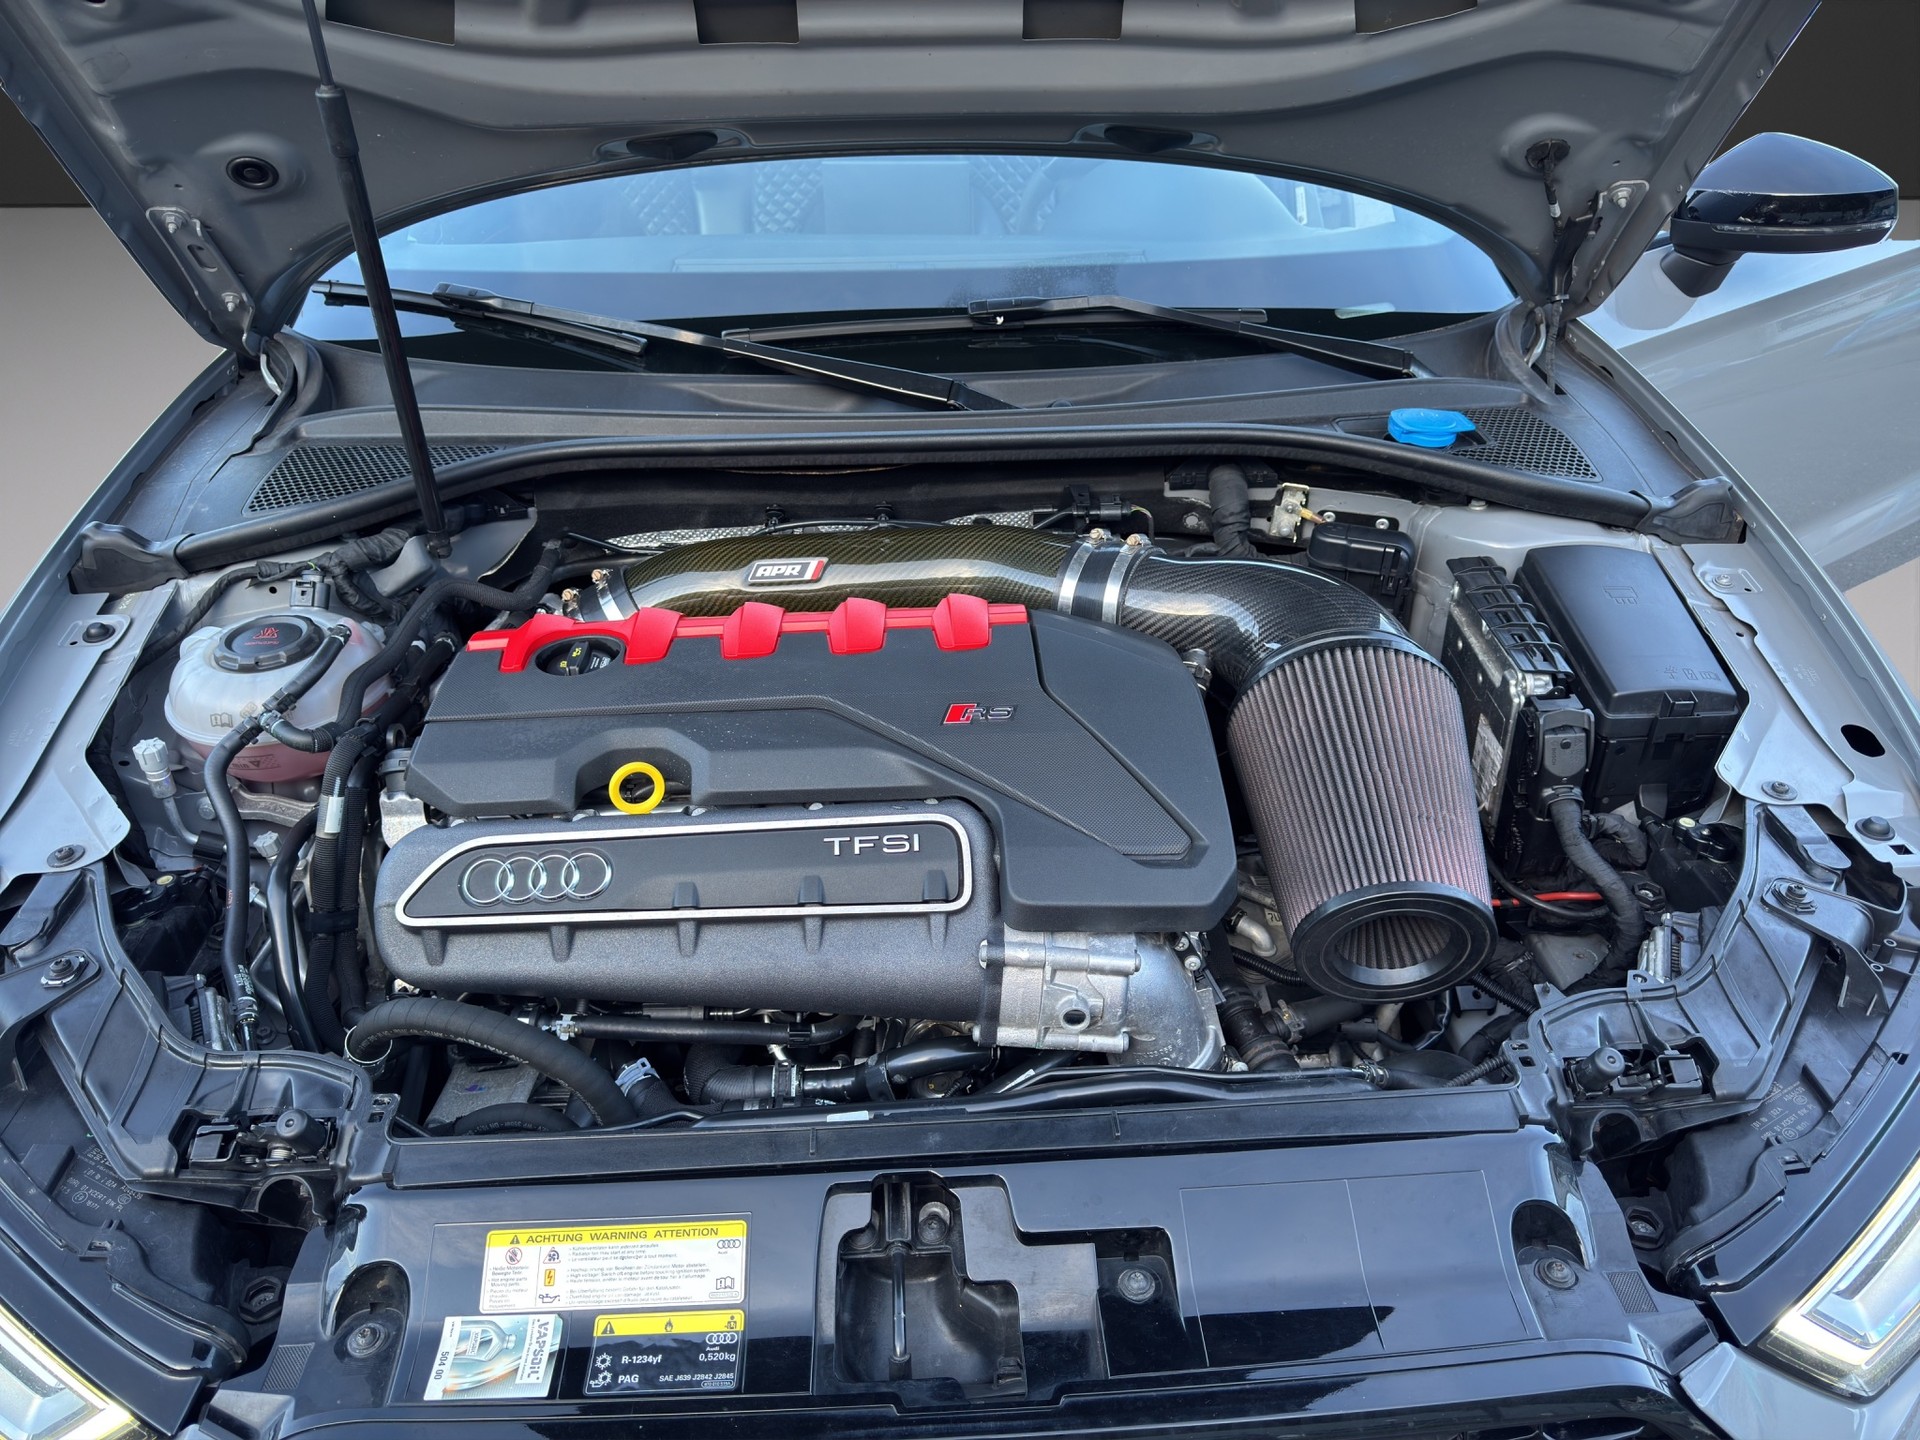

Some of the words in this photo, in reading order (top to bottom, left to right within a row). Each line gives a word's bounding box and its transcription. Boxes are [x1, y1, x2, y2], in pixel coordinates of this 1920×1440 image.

[755, 564, 802, 578] APR
[958, 705, 1013, 721] RS
[823, 833, 920, 856] TFSI
[526, 1233, 584, 1244] ACHTUNG
[589, 1230, 648, 1241] WARNING
[653, 1227, 719, 1238] ATTENTION
[438, 1351, 450, 1366] 504
[621, 1354, 662, 1365] R-1234yf
[433, 1369, 444, 1380] 00
[618, 1374, 639, 1384] PAG
[659, 1374, 674, 1382] SAE
[692, 1373, 713, 1381] J2842
[714, 1372, 735, 1380] J2845
